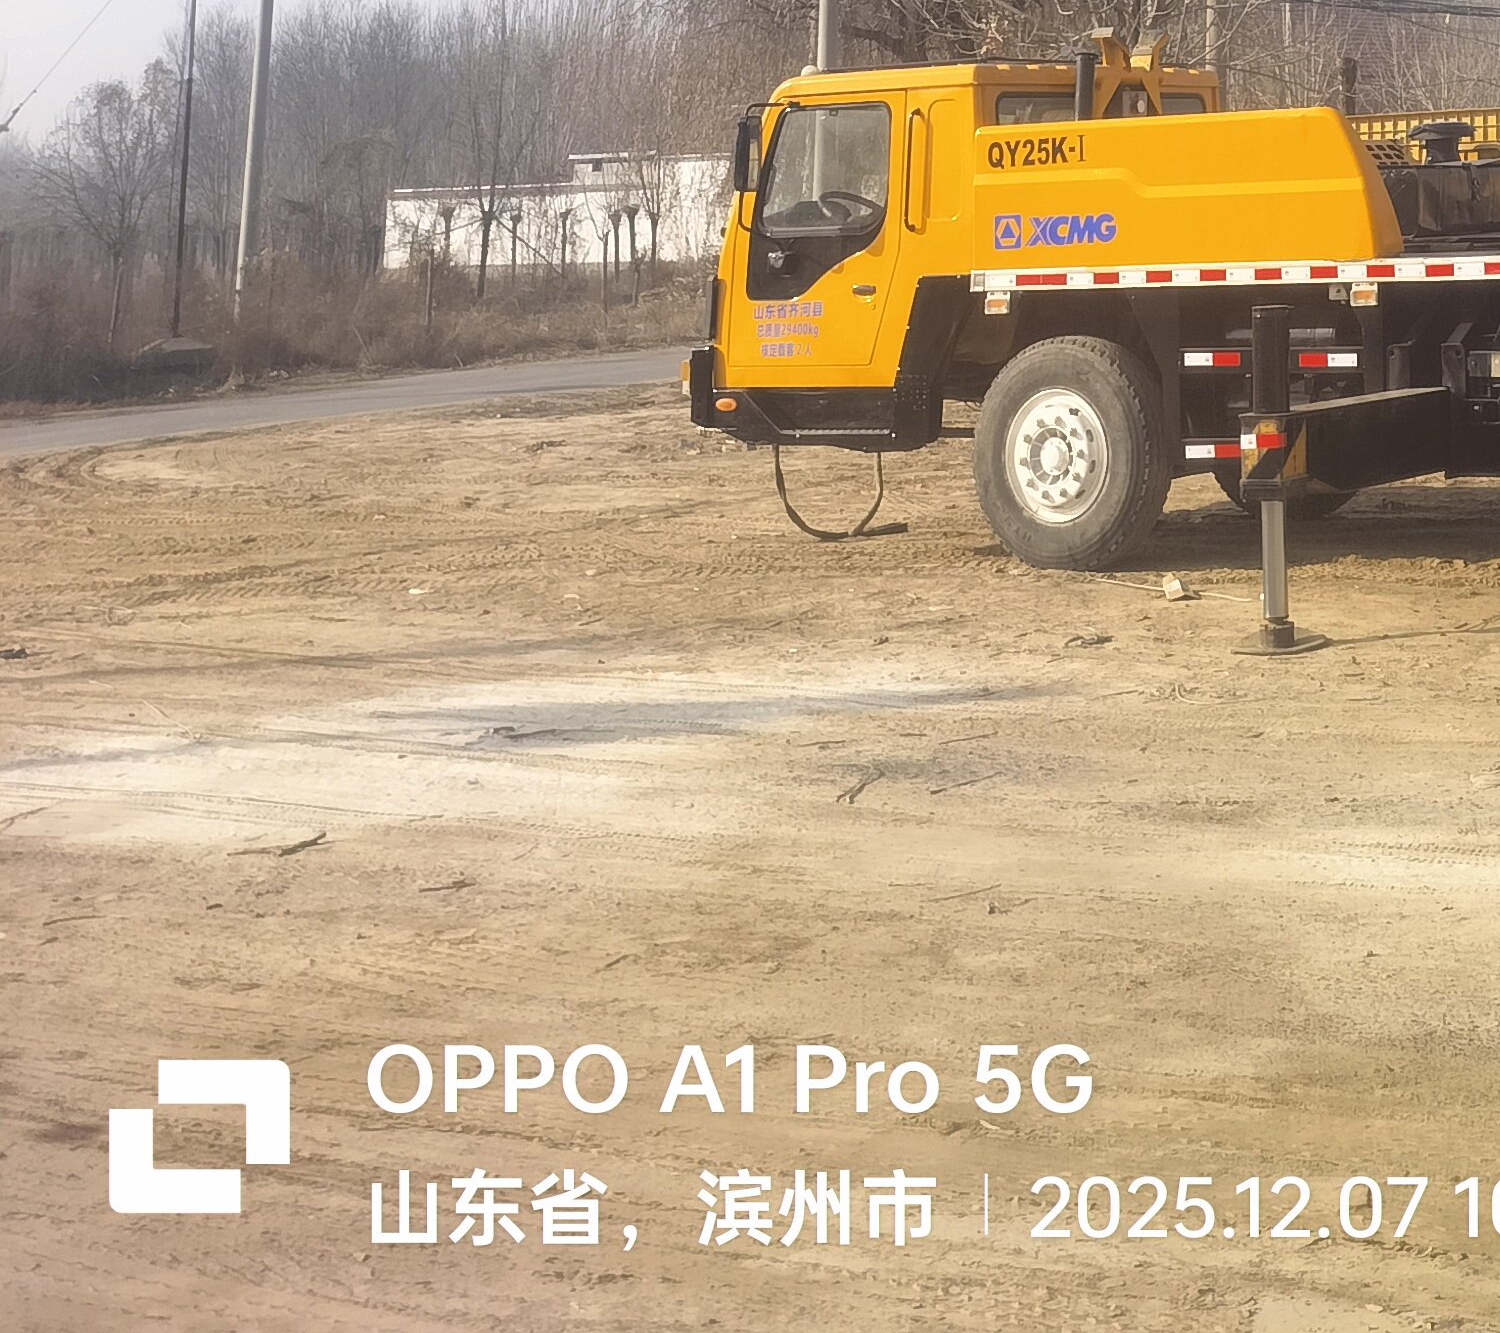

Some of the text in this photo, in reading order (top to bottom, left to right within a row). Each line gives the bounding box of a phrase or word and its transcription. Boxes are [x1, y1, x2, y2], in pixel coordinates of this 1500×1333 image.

[1025, 212, 1117, 247] XCMG
[753, 301, 823, 320] 山东省齐河县
